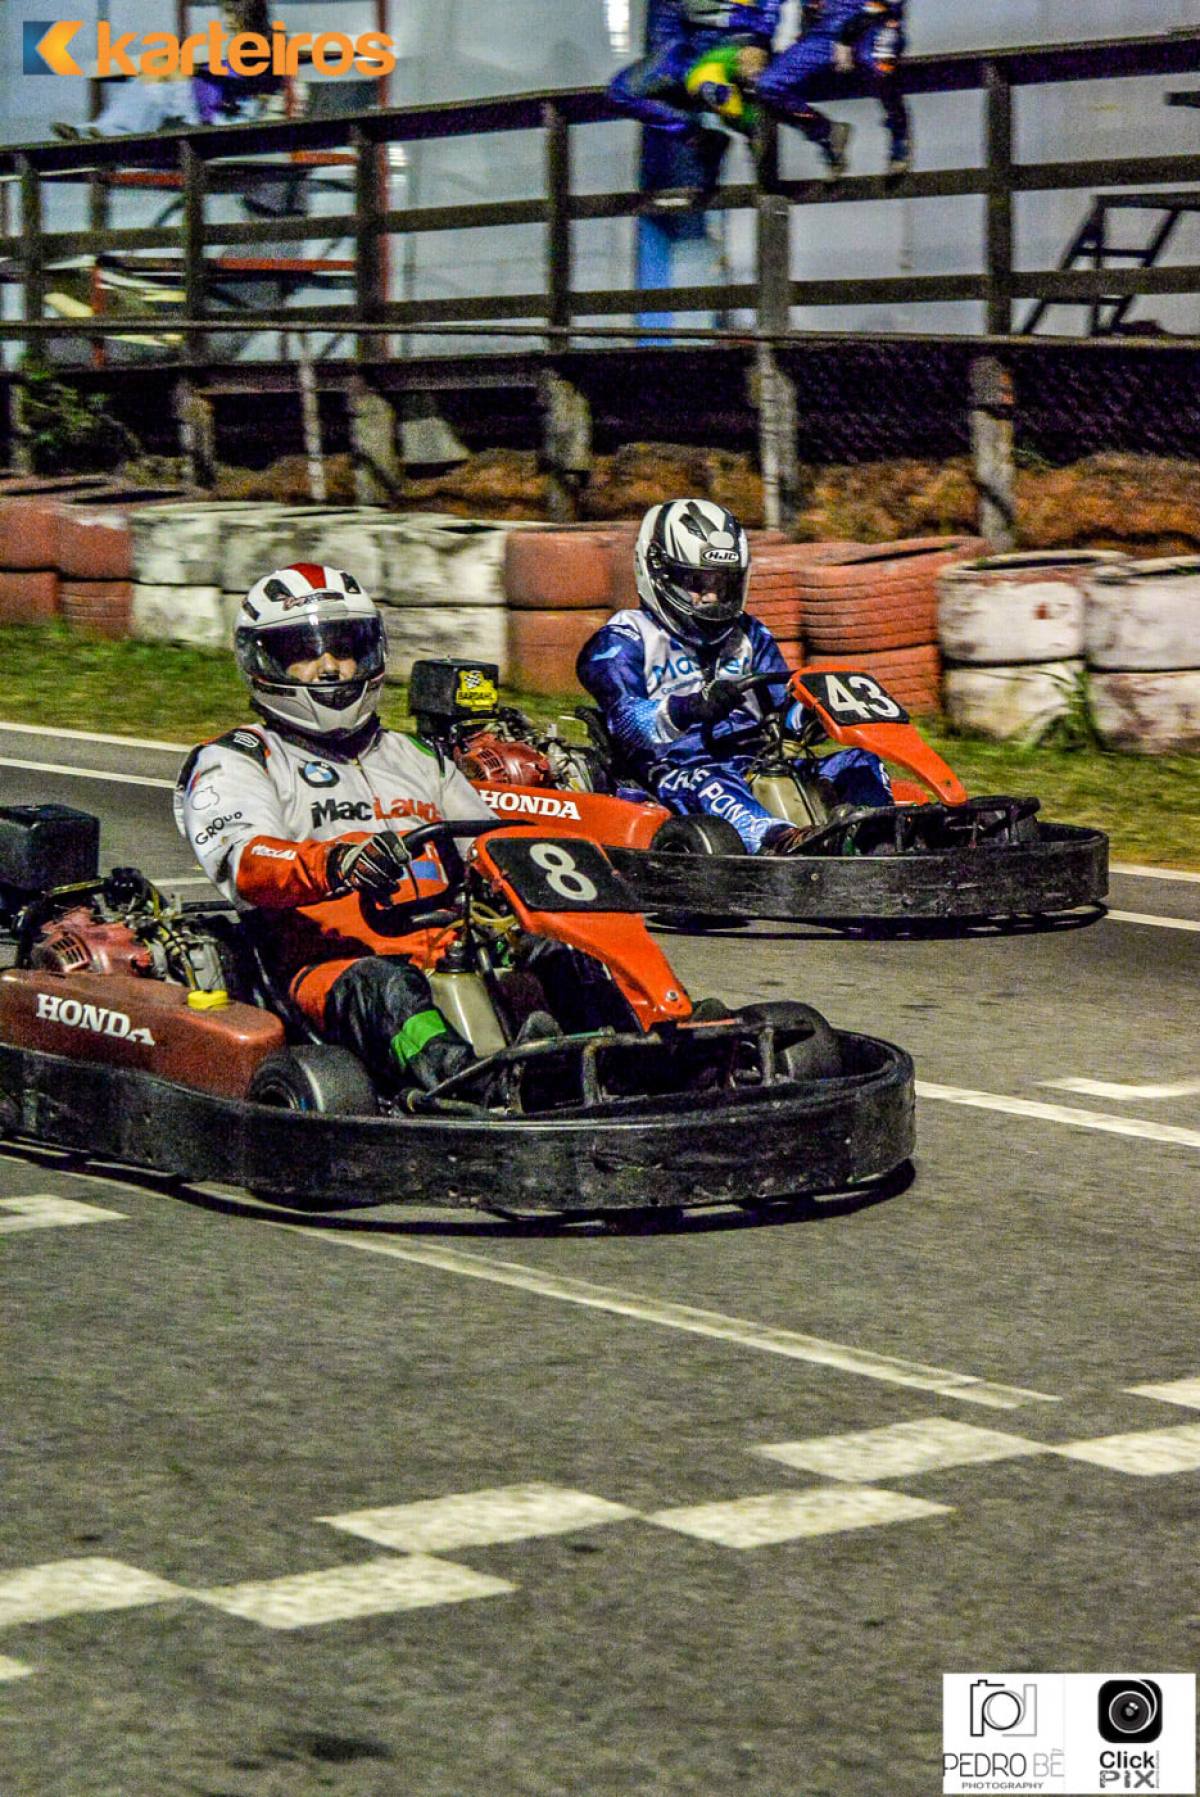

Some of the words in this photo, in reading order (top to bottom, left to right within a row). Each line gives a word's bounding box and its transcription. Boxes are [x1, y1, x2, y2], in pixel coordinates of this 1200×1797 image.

[708, 551, 736, 560] HJC
[825, 674, 900, 719] 43
[479, 789, 581, 821] HONDA
[529, 842, 598, 901] 8
[36, 993, 156, 1047] HONDA
